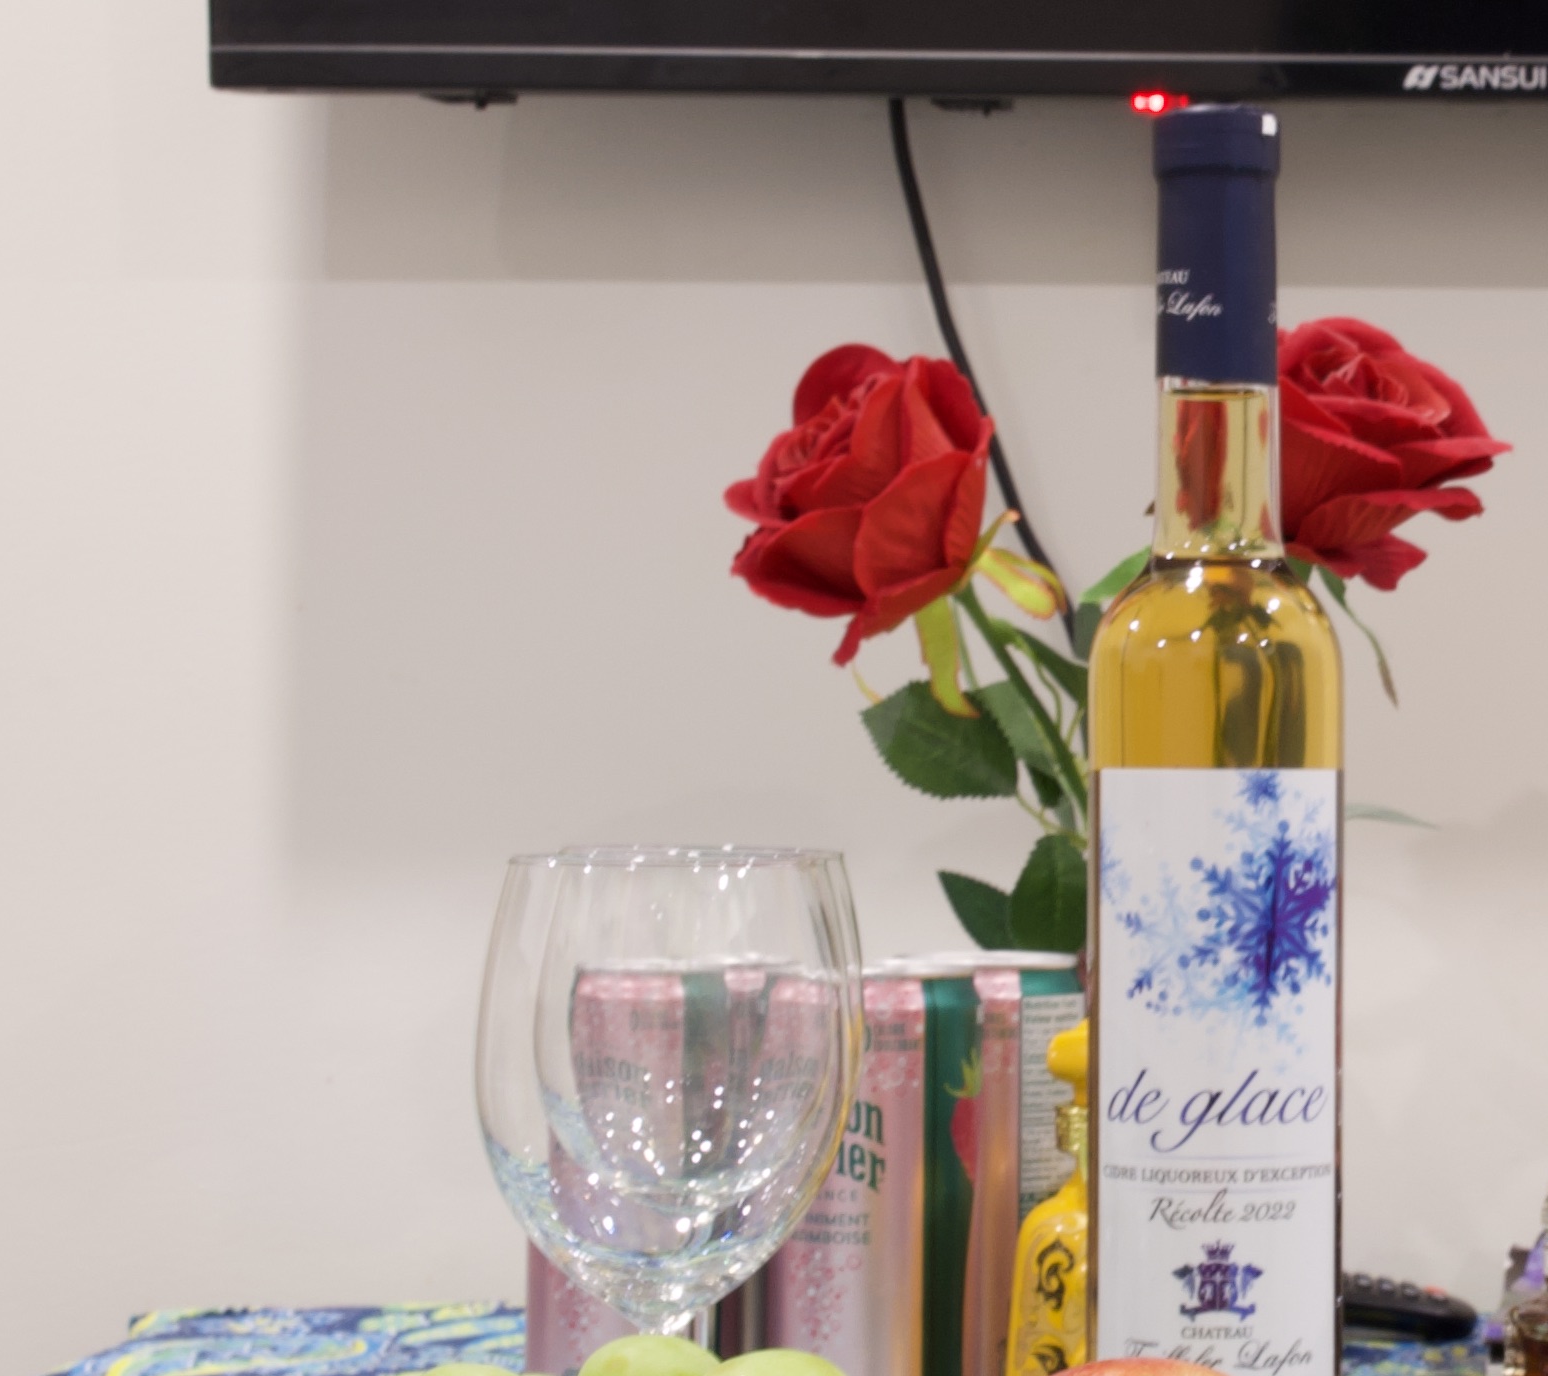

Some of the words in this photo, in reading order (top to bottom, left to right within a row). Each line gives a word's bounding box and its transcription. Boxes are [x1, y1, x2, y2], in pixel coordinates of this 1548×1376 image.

[1439, 65, 1548, 90] SANSUI
[1107, 1068, 1170, 1125] de
[1150, 1068, 1329, 1153] glace
[1141, 1167, 1238, 1185] LIQUOREUX
[1243, 1164, 1332, 1184] D'EXCEPTION
[1149, 1188, 1235, 1230] Récolte
[1239, 1200, 1297, 1222] 2022
[1233, 1337, 1313, 1376] Lafon
